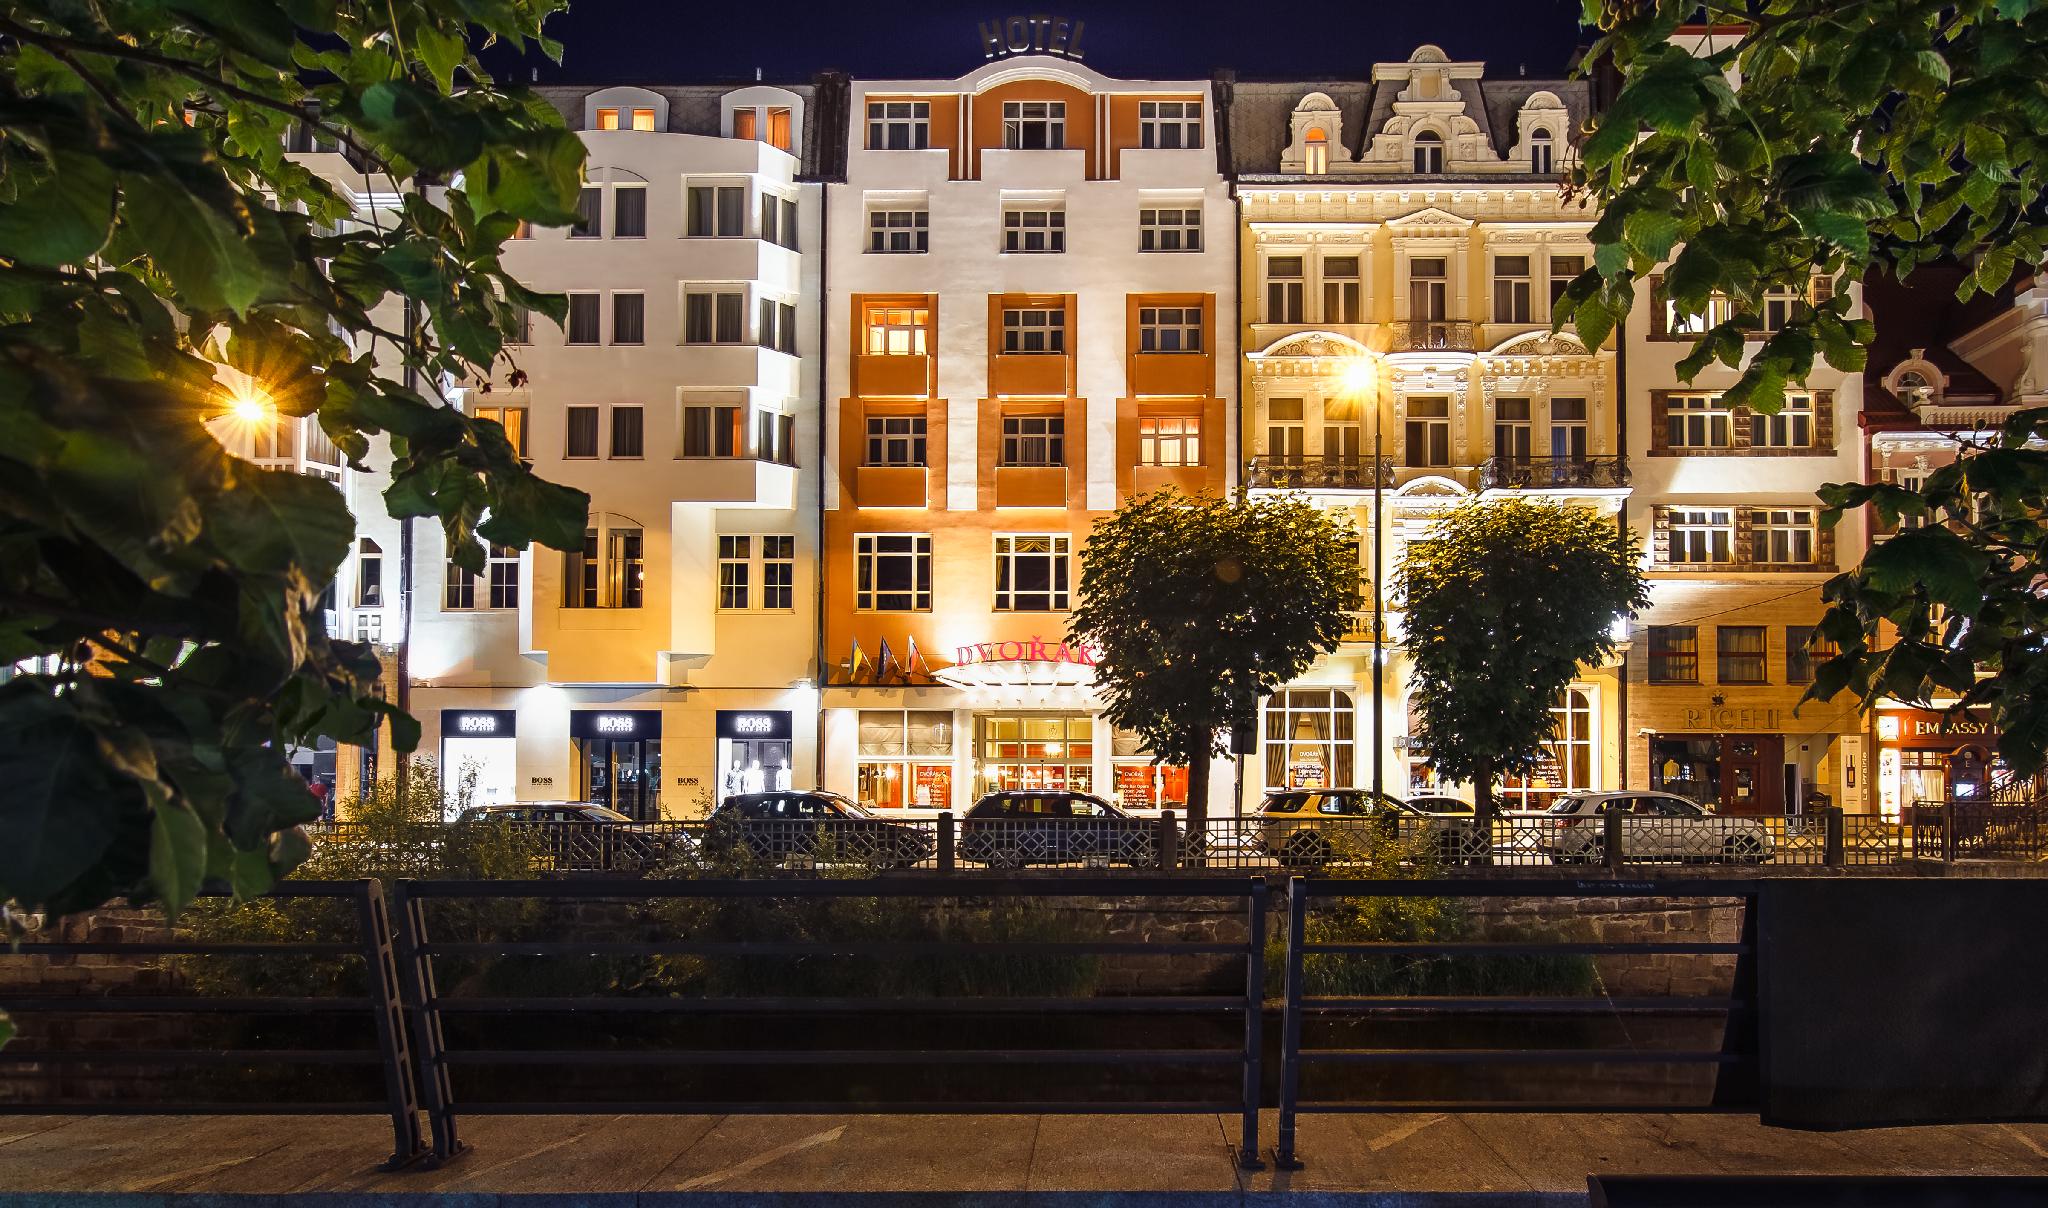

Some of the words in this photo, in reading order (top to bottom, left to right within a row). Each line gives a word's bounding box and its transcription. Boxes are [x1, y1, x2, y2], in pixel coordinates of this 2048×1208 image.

[979, 14, 1085, 58] HOTEL
[460, 716, 496, 728] BOSS
[599, 716, 633, 728] BOSS
[737, 716, 771, 728] BOSS
[1915, 720, 1988, 736] EMASSY
